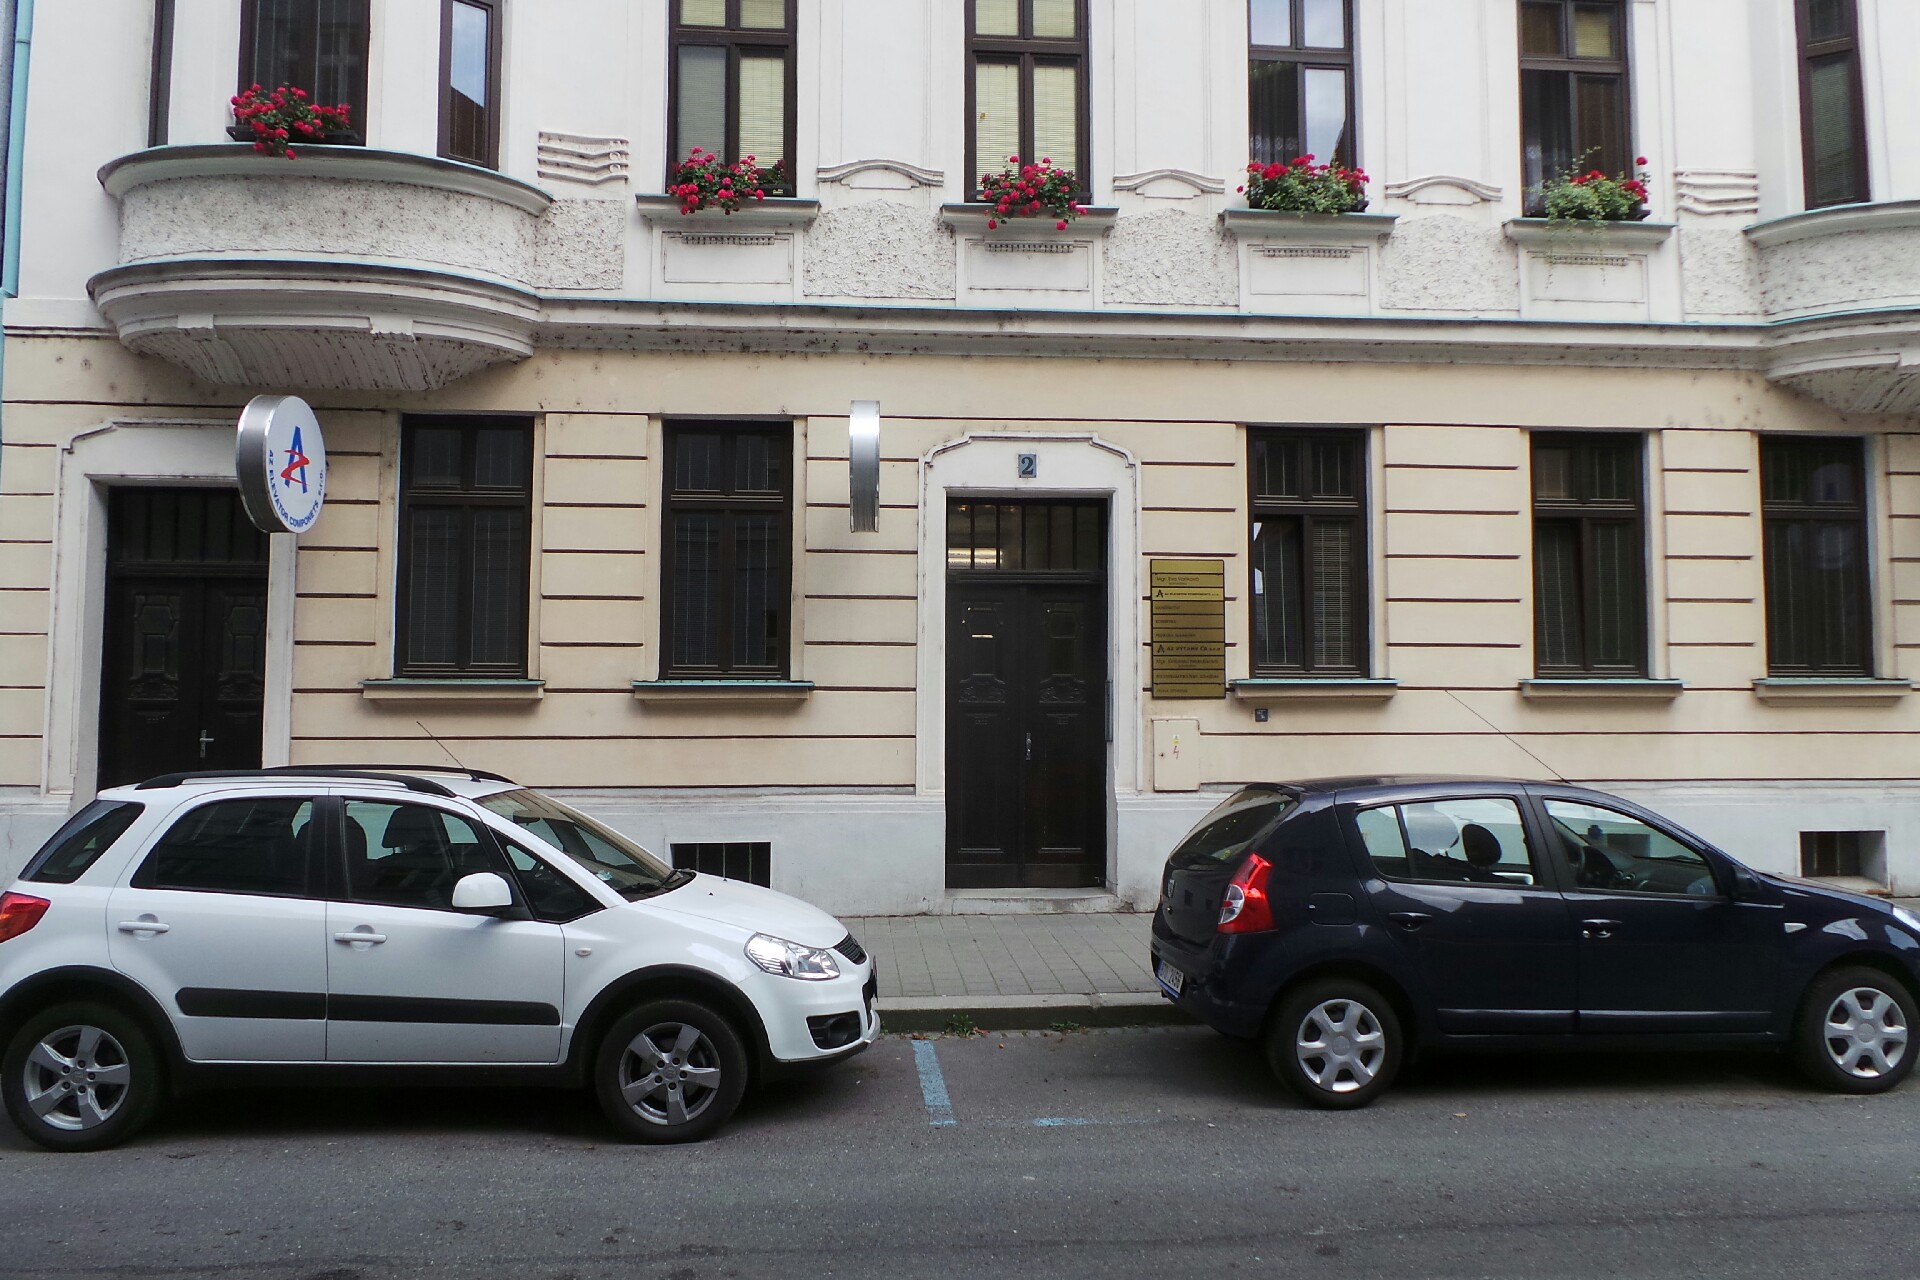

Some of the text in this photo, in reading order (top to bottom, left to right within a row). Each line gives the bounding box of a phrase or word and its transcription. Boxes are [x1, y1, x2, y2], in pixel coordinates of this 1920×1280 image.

[268, 449, 274, 466] AZ
[1021, 456, 1034, 475] 2
[269, 469, 289, 522] ELEVATOR
